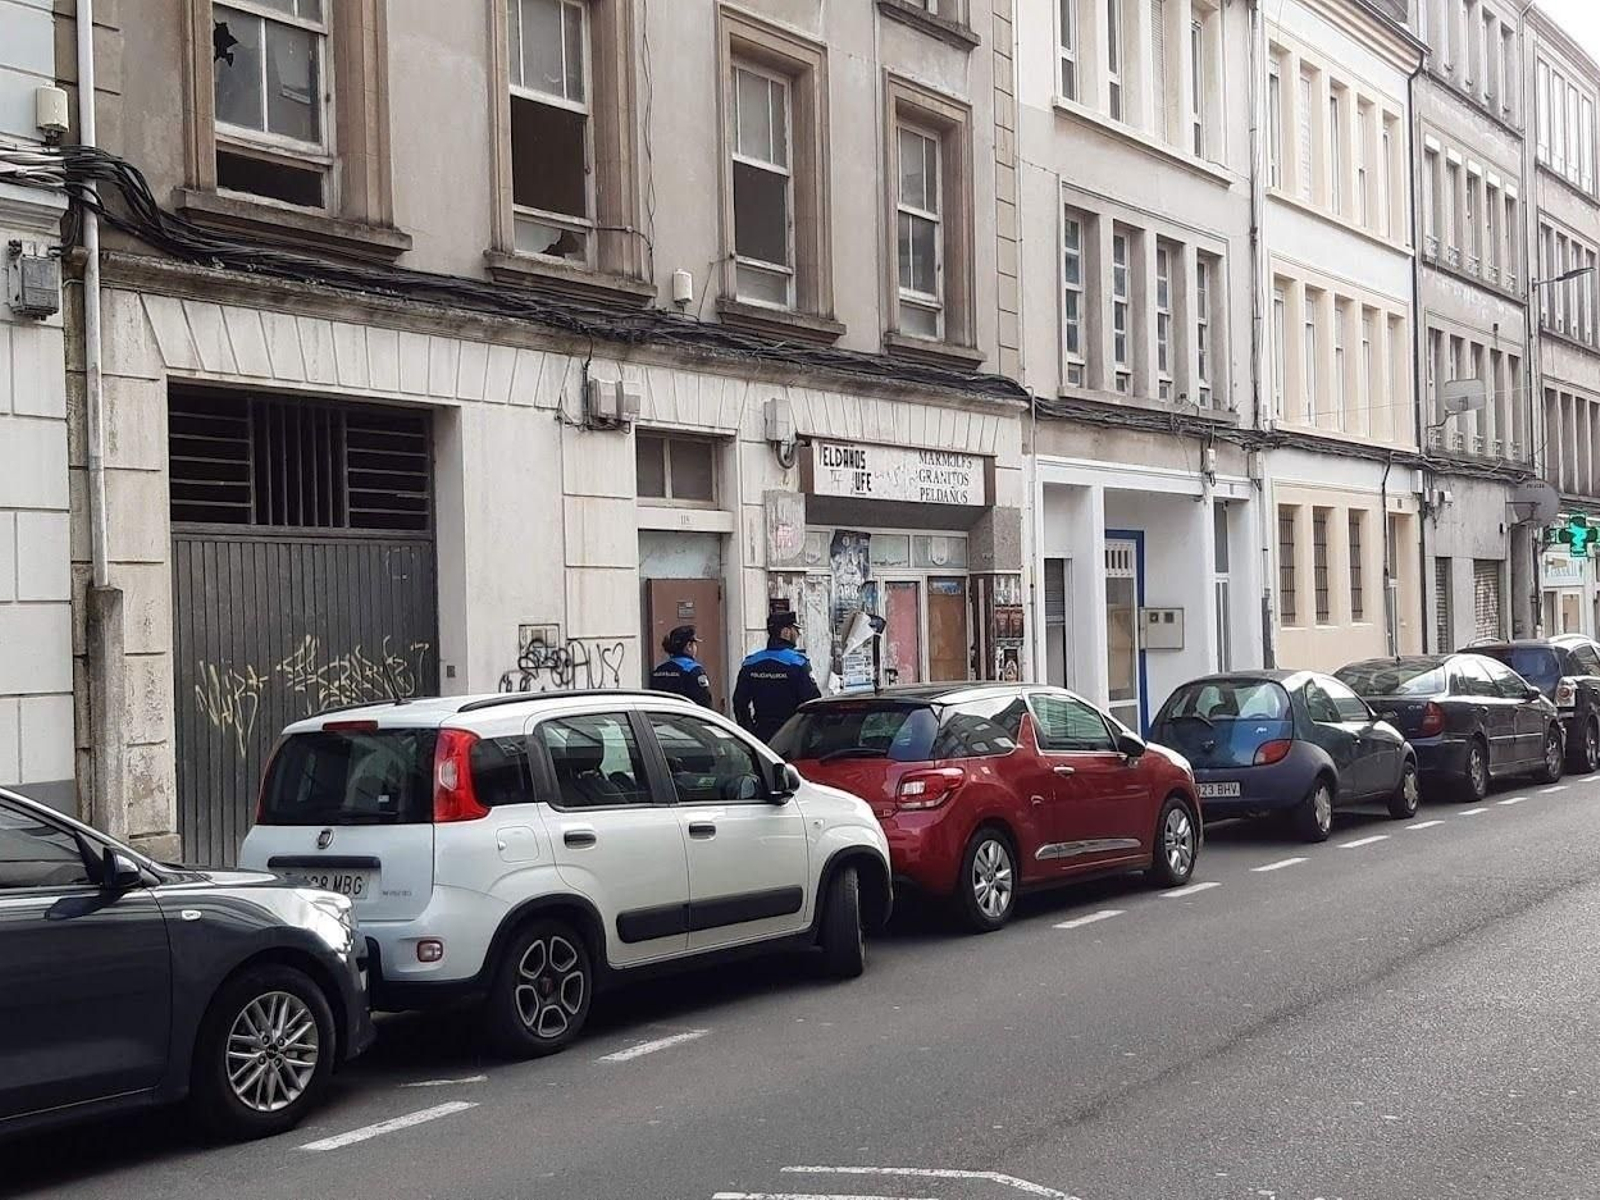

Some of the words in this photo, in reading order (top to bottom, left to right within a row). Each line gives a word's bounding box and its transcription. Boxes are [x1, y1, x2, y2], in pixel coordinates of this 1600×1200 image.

[919, 469, 969, 486] GRANITOS
[920, 485, 968, 503] PELDAÑOS
[1217, 784, 1237, 795] BHV
[333, 875, 363, 895] MBG
